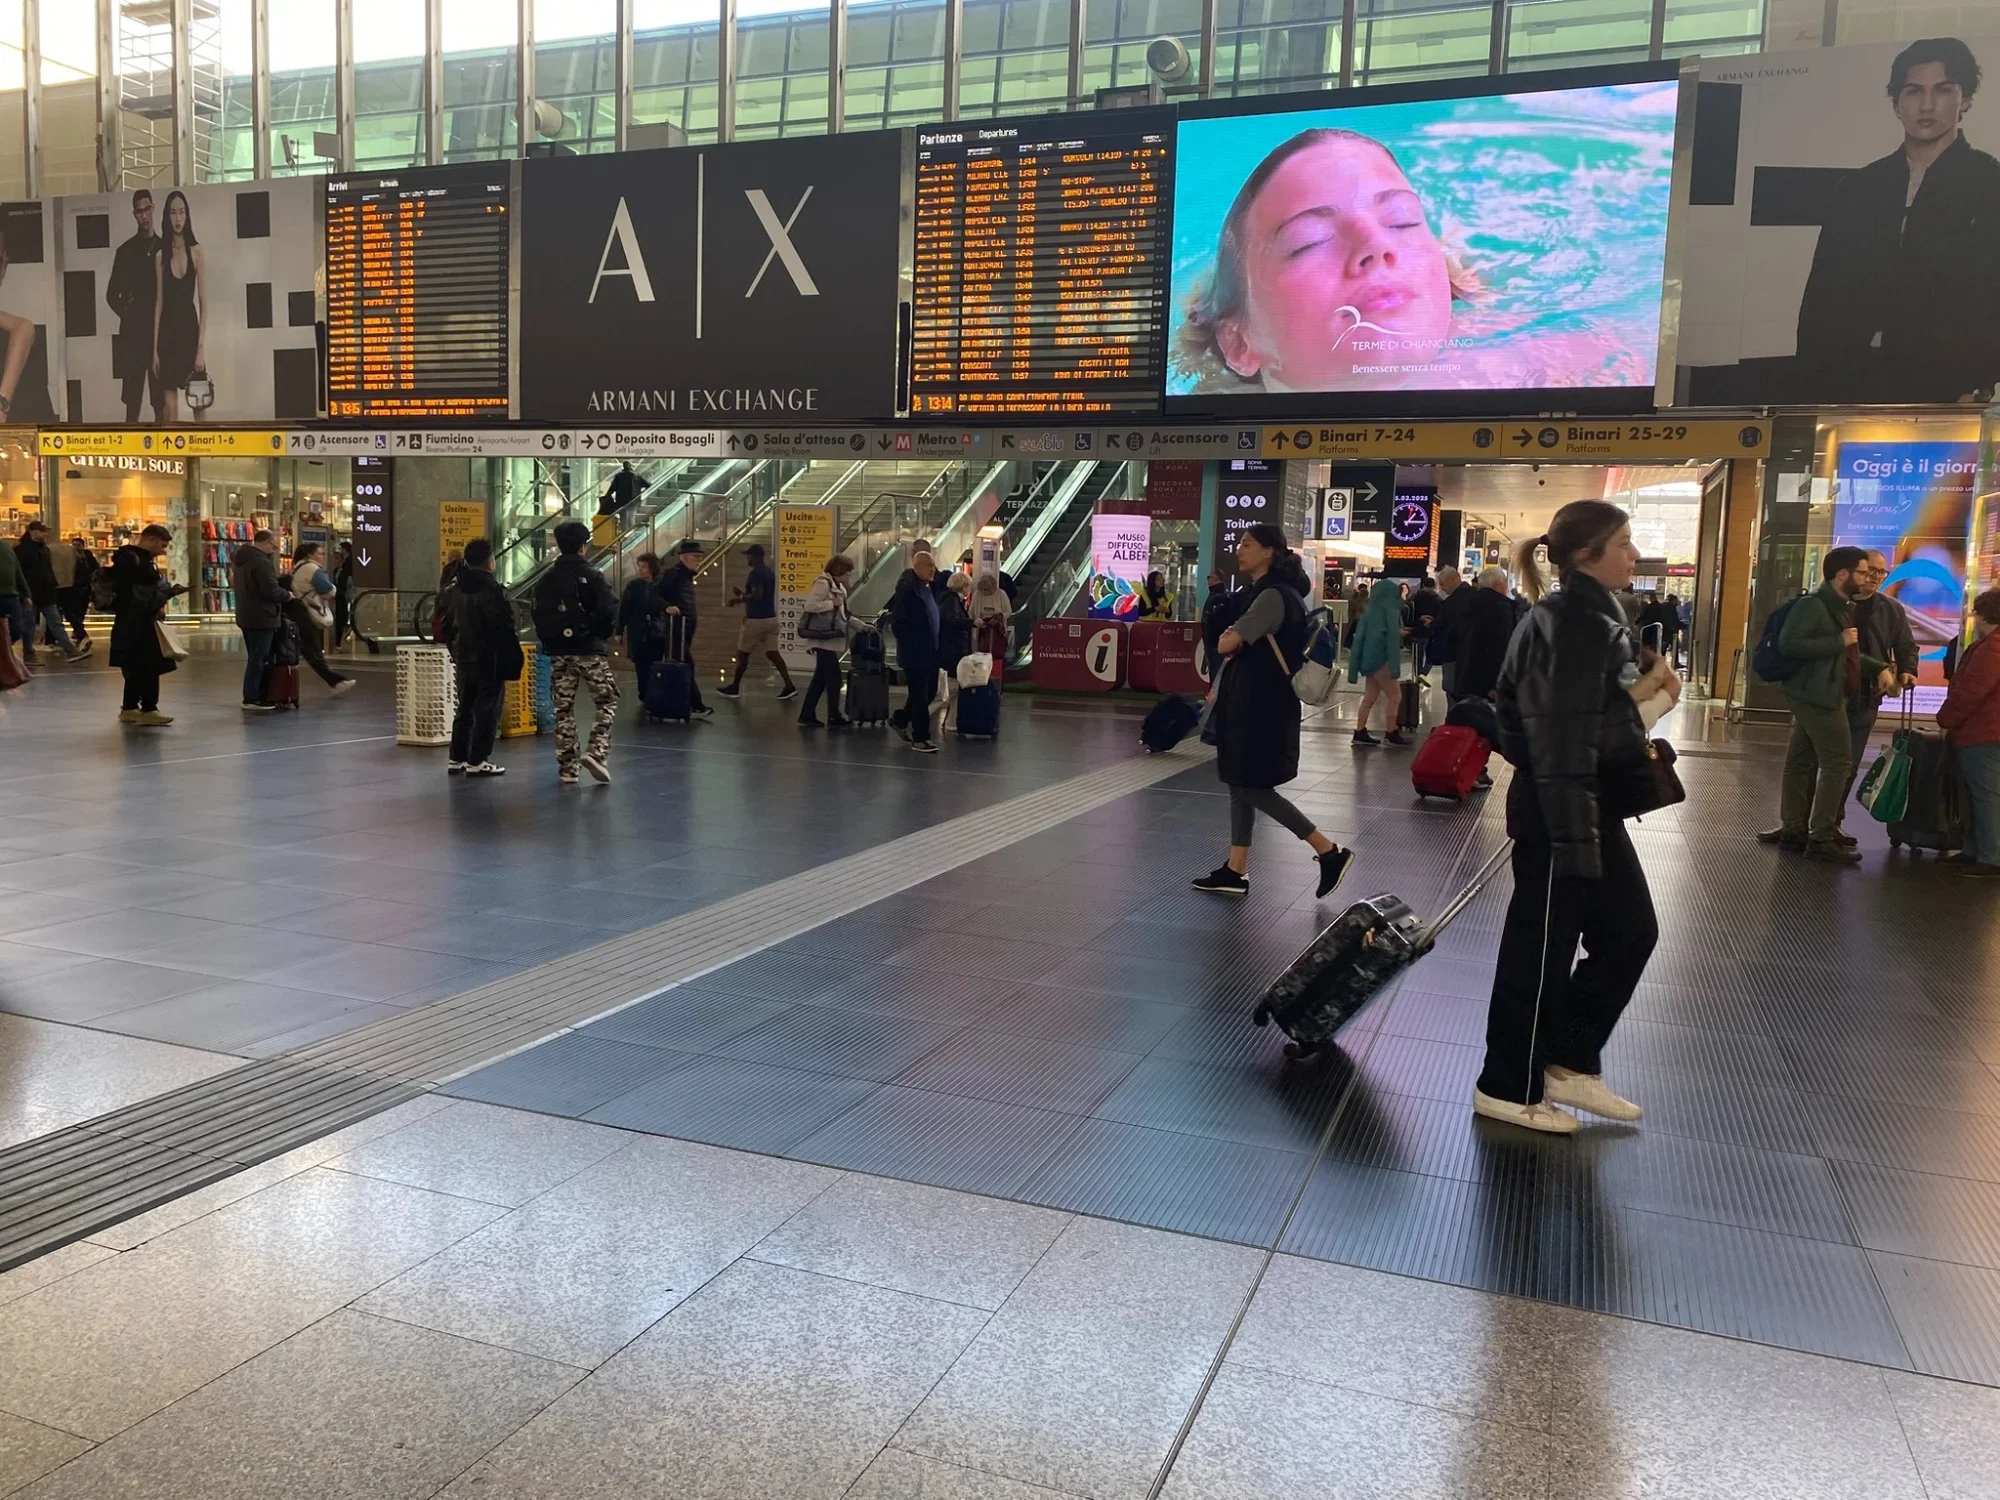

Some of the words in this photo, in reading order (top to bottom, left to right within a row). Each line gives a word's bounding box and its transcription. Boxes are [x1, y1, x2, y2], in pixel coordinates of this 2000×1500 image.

[1716, 71, 1754, 81] ARMANI
[1758, 66, 1810, 78] EXCHANGE
[920, 133, 963, 145] Partenze
[979, 128, 1018, 139] Departures
[328, 182, 348, 192] Arrivi
[1352, 340, 1386, 351] TERME
[1388, 341, 1399, 350] DI
[1401, 338, 1474, 349] CHIANCIANO
[1352, 364, 1400, 374] Benessere
[1401, 364, 1429, 372] senza
[1430, 363, 1461, 374] tempo
[587, 389, 676, 411] ARMANI
[689, 388, 818, 411] EXCHANGE
[425, 433, 474, 444] Fiumicino
[763, 434, 790, 445] Sala
[794, 433, 845, 445] d'attesa
[1150, 431, 1229, 445] Ascensore
[1319, 429, 1369, 442] Binari
[1374, 428, 1416, 442] 7-24
[1567, 426, 1621, 441] Binari
[1628, 426, 1687, 441] 25-29
[66, 435, 91, 445] Binari
[93, 437, 105, 445] est
[108, 435, 123, 444] 1-2
[188, 435, 215, 445] Binari
[217, 435, 235, 445] 1-6
[319, 434, 370, 446] Ascensore
[615, 433, 666, 446] Deposito
[669, 433, 715, 446] Bagagli
[897, 435, 912, 450] M
[917, 433, 957, 445] Metro
[615, 446, 626, 454] Left
[627, 447, 655, 455] Luggage
[763, 446, 790, 456] Waiting
[917, 447, 965, 456] Underground
[1319, 444, 1359, 455] Platforms
[1566, 443, 1611, 454] Platforms
[118, 456, 147, 471] DEL
[149, 457, 184, 475] SOLE
[1853, 459, 1898, 478] Oggi
[1902, 458, 1913, 473] è
[1919, 459, 1929, 473] il
[356, 504, 381, 512] Toilets
[445, 504, 468, 513] Uscite
[1849, 499, 1912, 516] Curious?
[785, 512, 813, 521] Uscite
[365, 523, 382, 532] floor
[1117, 533, 1145, 541] MUSEO
[1224, 532, 1236, 541] at
[1108, 541, 1143, 550] DIFFUSO
[1223, 544, 1233, 553] -1
[785, 549, 808, 558] Treni
